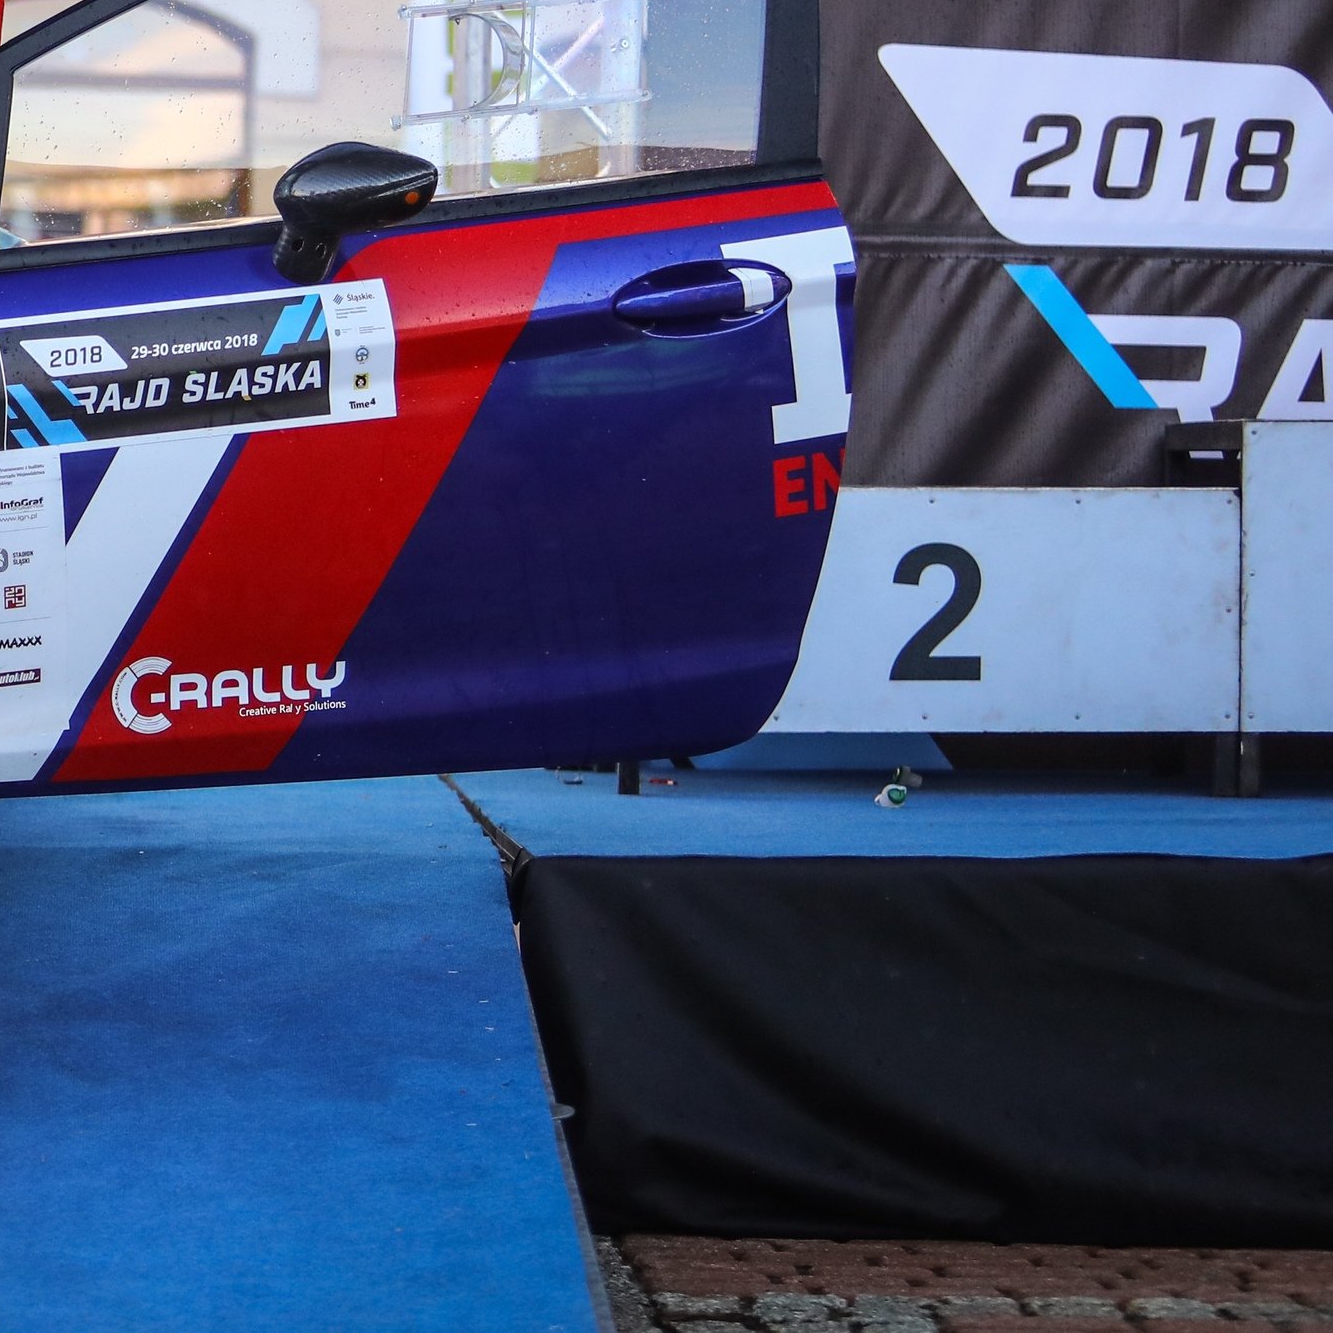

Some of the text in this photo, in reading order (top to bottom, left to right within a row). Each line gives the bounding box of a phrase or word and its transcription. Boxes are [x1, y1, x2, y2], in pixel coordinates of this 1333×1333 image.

[1010, 113, 1296, 203] 2018
[346, 292, 375, 303] Śląskie.
[131, 333, 258, 359] 29-30 czerwca 2018
[50, 346, 102, 368] 2018
[69, 378, 170, 415] RAJD
[349, 397, 376, 410] Time4
[1, 496, 44, 510] InfoGraf
[13, 550, 34, 559] STADION
[889, 542, 982, 681] 2
[239, 700, 346, 717] Creative Solutions
